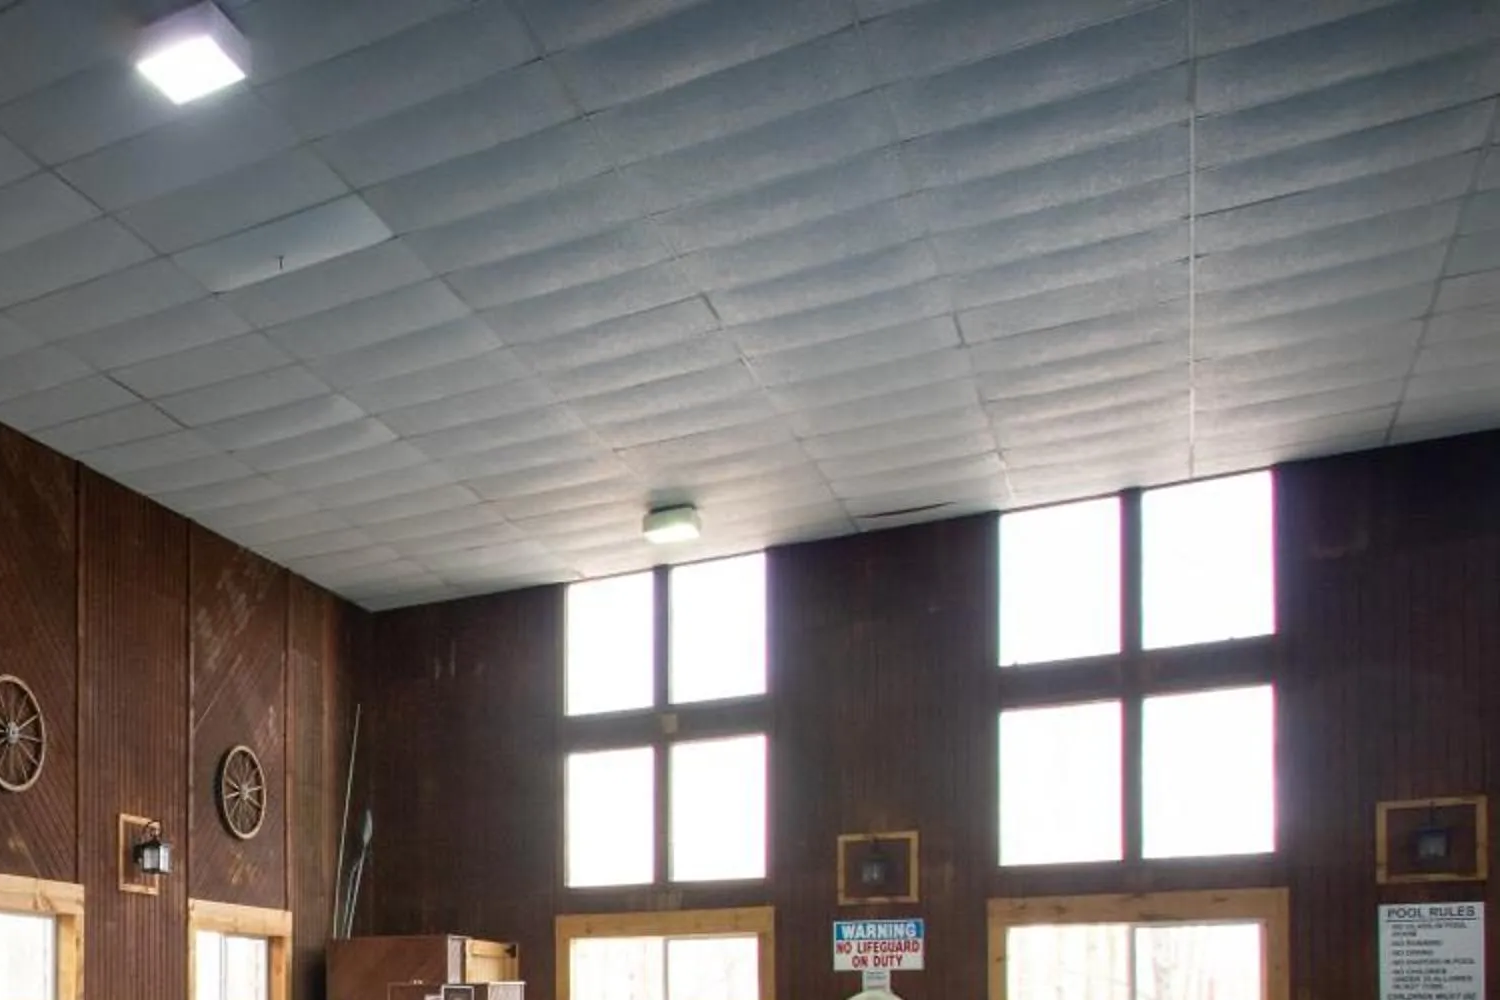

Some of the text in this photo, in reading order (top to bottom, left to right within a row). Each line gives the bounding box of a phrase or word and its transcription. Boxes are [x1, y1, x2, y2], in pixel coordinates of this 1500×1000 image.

[1387, 905, 1476, 918] POOL RULES
[841, 922, 917, 939] WARNING
[836, 940, 920, 954] NO LIFEGUARD
[852, 955, 903, 968] ON DUTY
